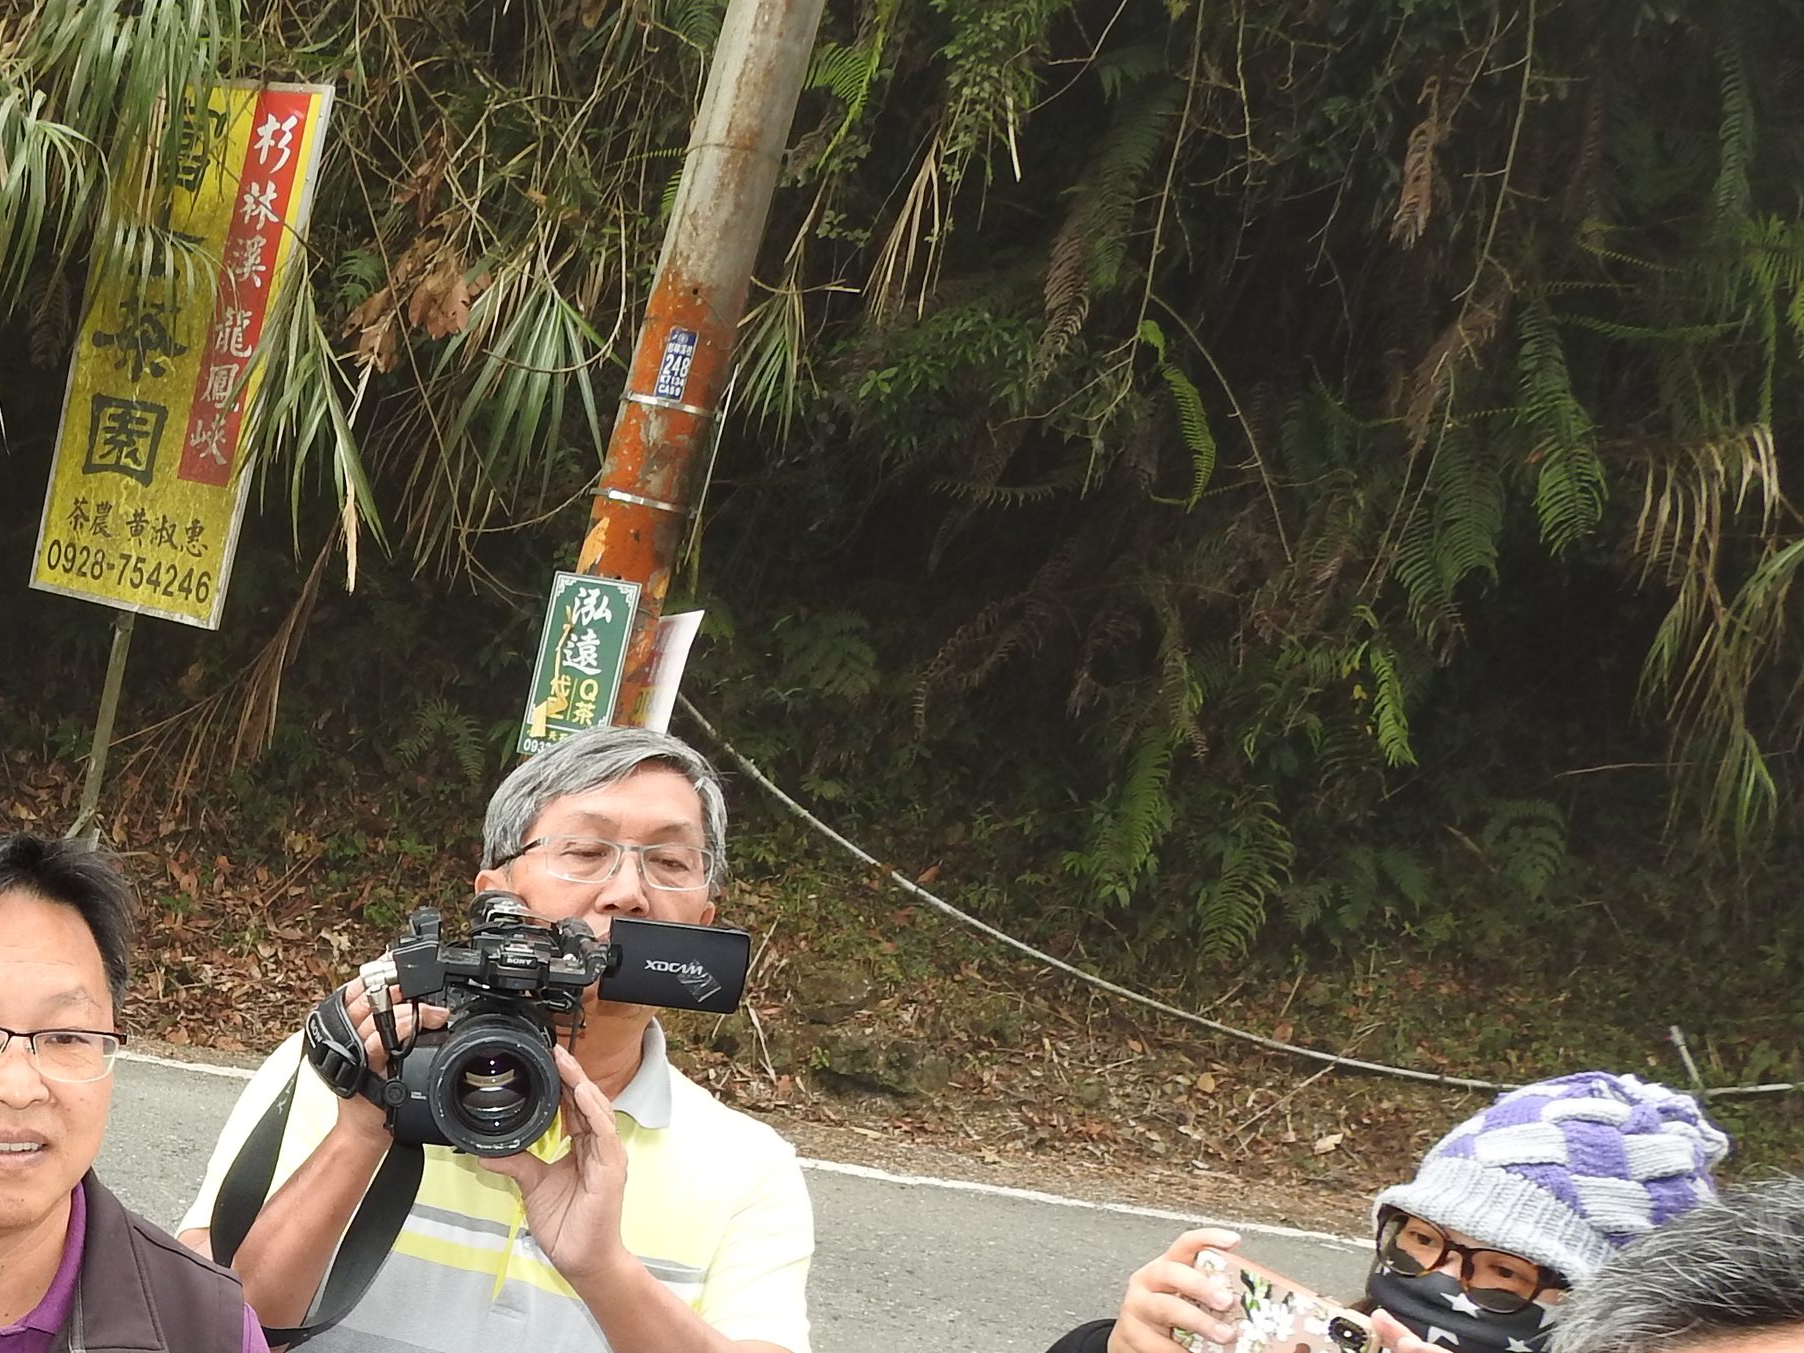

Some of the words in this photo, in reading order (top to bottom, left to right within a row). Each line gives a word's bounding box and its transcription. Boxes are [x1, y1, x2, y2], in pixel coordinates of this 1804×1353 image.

[662, 354, 690, 378] 248
[48, 539, 211, 604] 0928-754246
[562, 587, 612, 676] 泓遠
